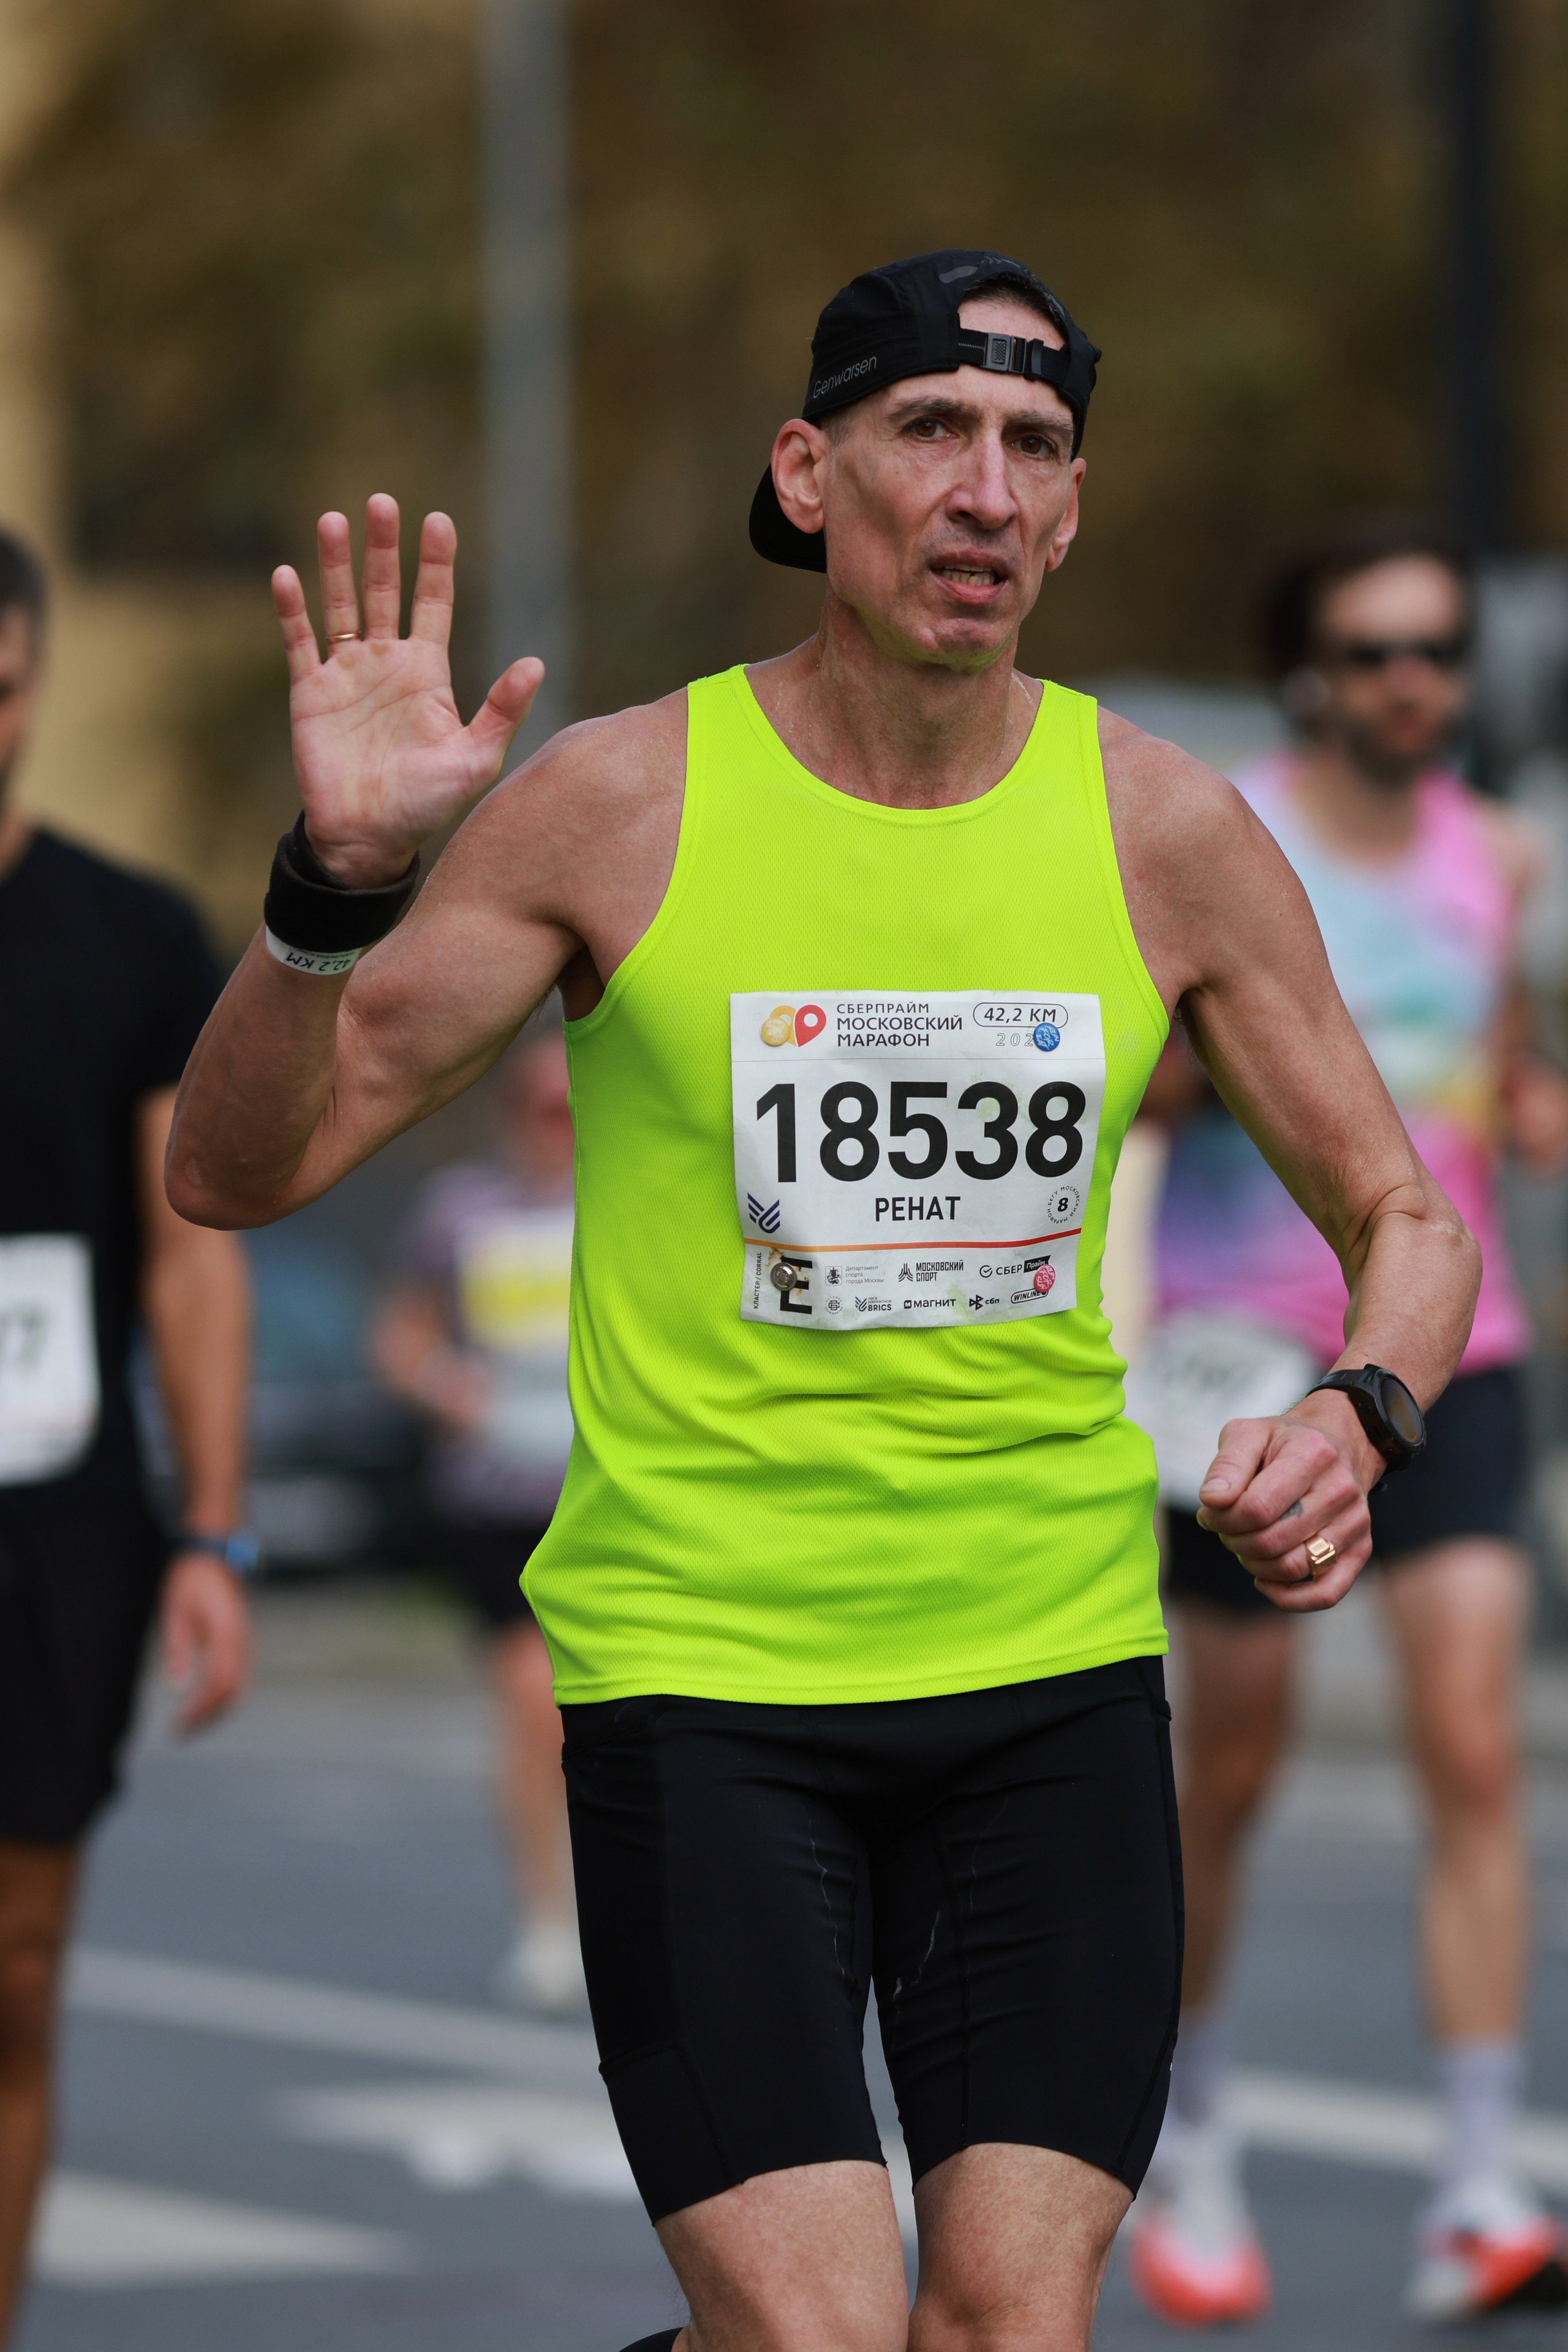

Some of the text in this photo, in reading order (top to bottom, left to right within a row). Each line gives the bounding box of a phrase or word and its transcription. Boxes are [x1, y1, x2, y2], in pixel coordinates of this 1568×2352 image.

[813, 356, 877, 399] Genwarsen
[318, 959, 351, 971] 42,2
[837, 1001, 929, 1014] СБЕРПРАЙМ
[837, 1014, 962, 1030] МОСКОВСКИЙ
[984, 1008, 1022, 1023] 42,2
[837, 1033, 929, 1047] МАРАФОН
[995, 1033, 1034, 1047] 202
[756, 1080, 1087, 1183] 18538
[875, 1196, 961, 1222] РЕНАТ
[1057, 1197, 1069, 1212] 8
[916, 1259, 964, 1272] МОСКОВСКИЙ
[996, 1259, 1046, 1275] СБЕР Прайм
[916, 1272, 938, 1282] СПОРТ
[1014, 1289, 1041, 1302] WINLINE
[913, 1298, 956, 1308] магнит
